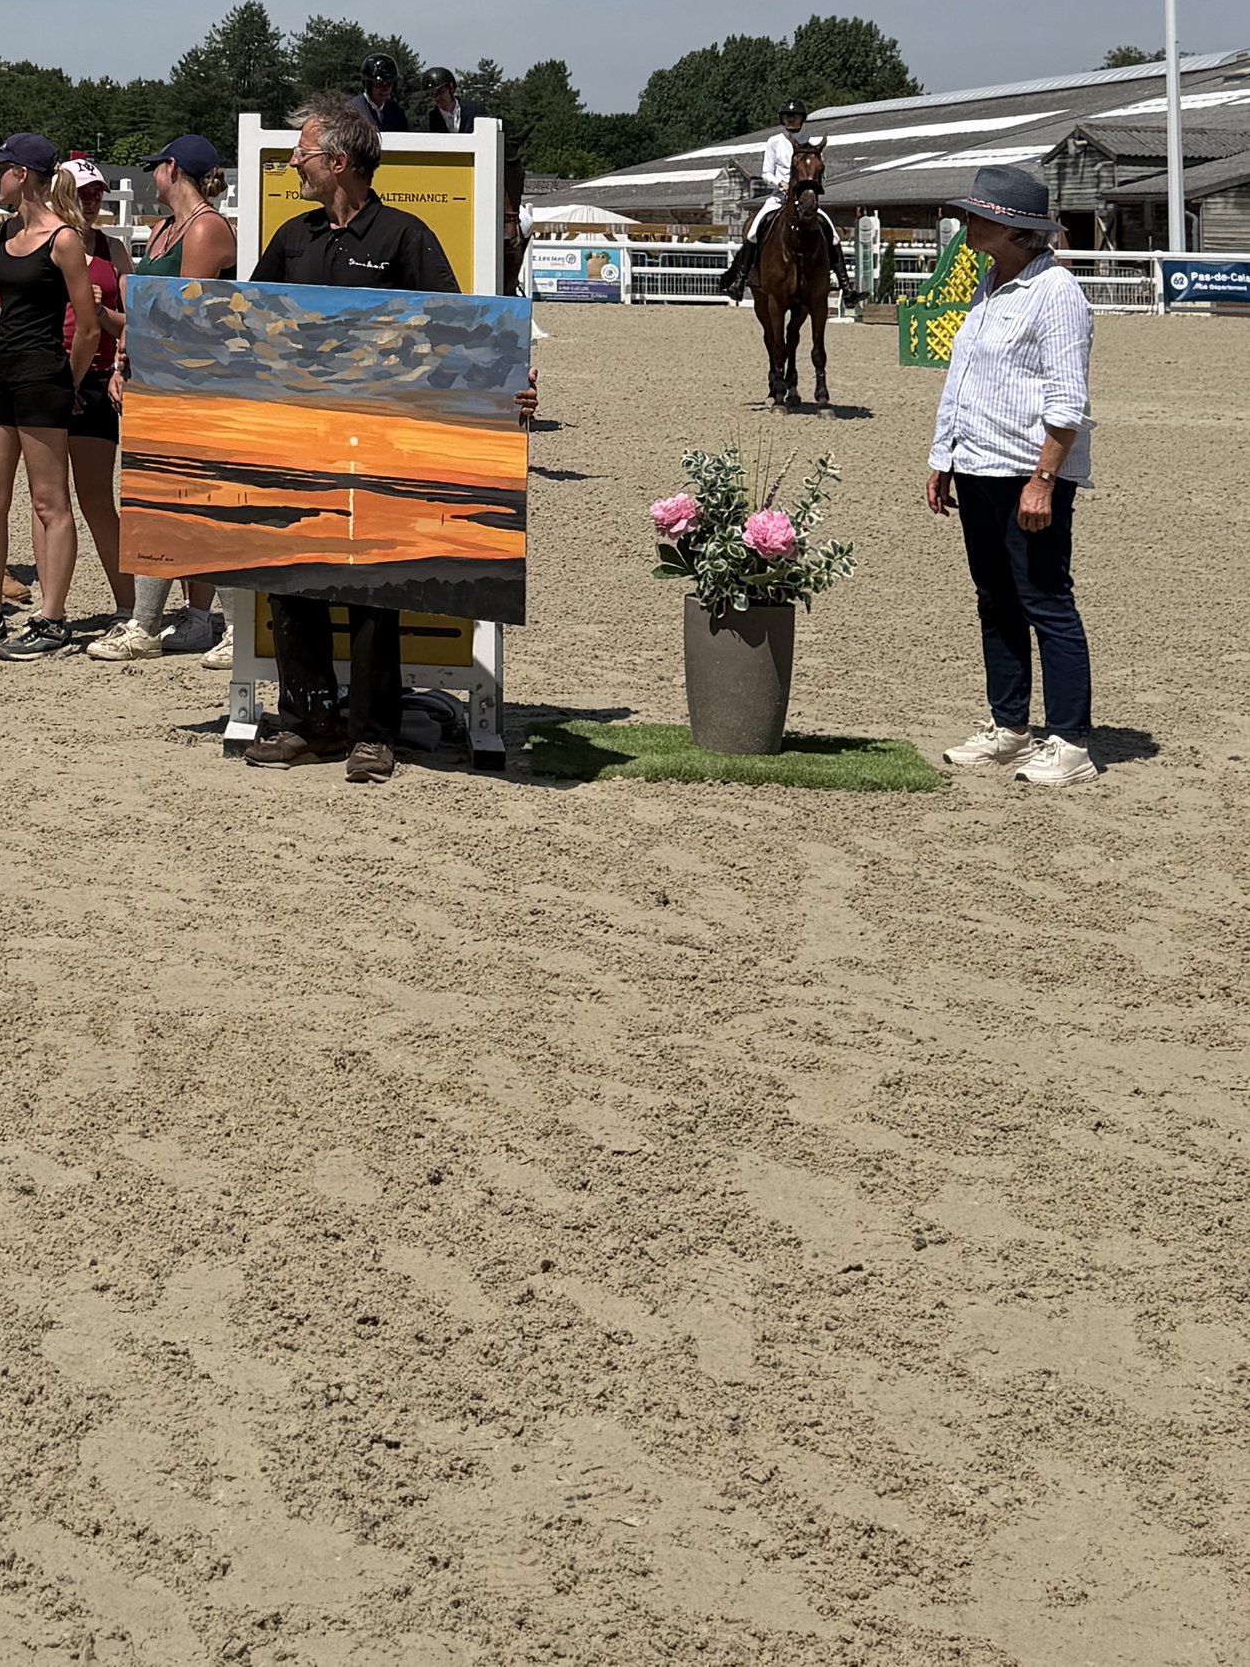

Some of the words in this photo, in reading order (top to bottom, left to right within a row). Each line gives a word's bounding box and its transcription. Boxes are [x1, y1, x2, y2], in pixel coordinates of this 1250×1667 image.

[380, 192, 448, 203] ALTERNANCE
[1173, 276, 1185, 285] 62
[1190, 272, 1250, 283] Pas-de-Cala
